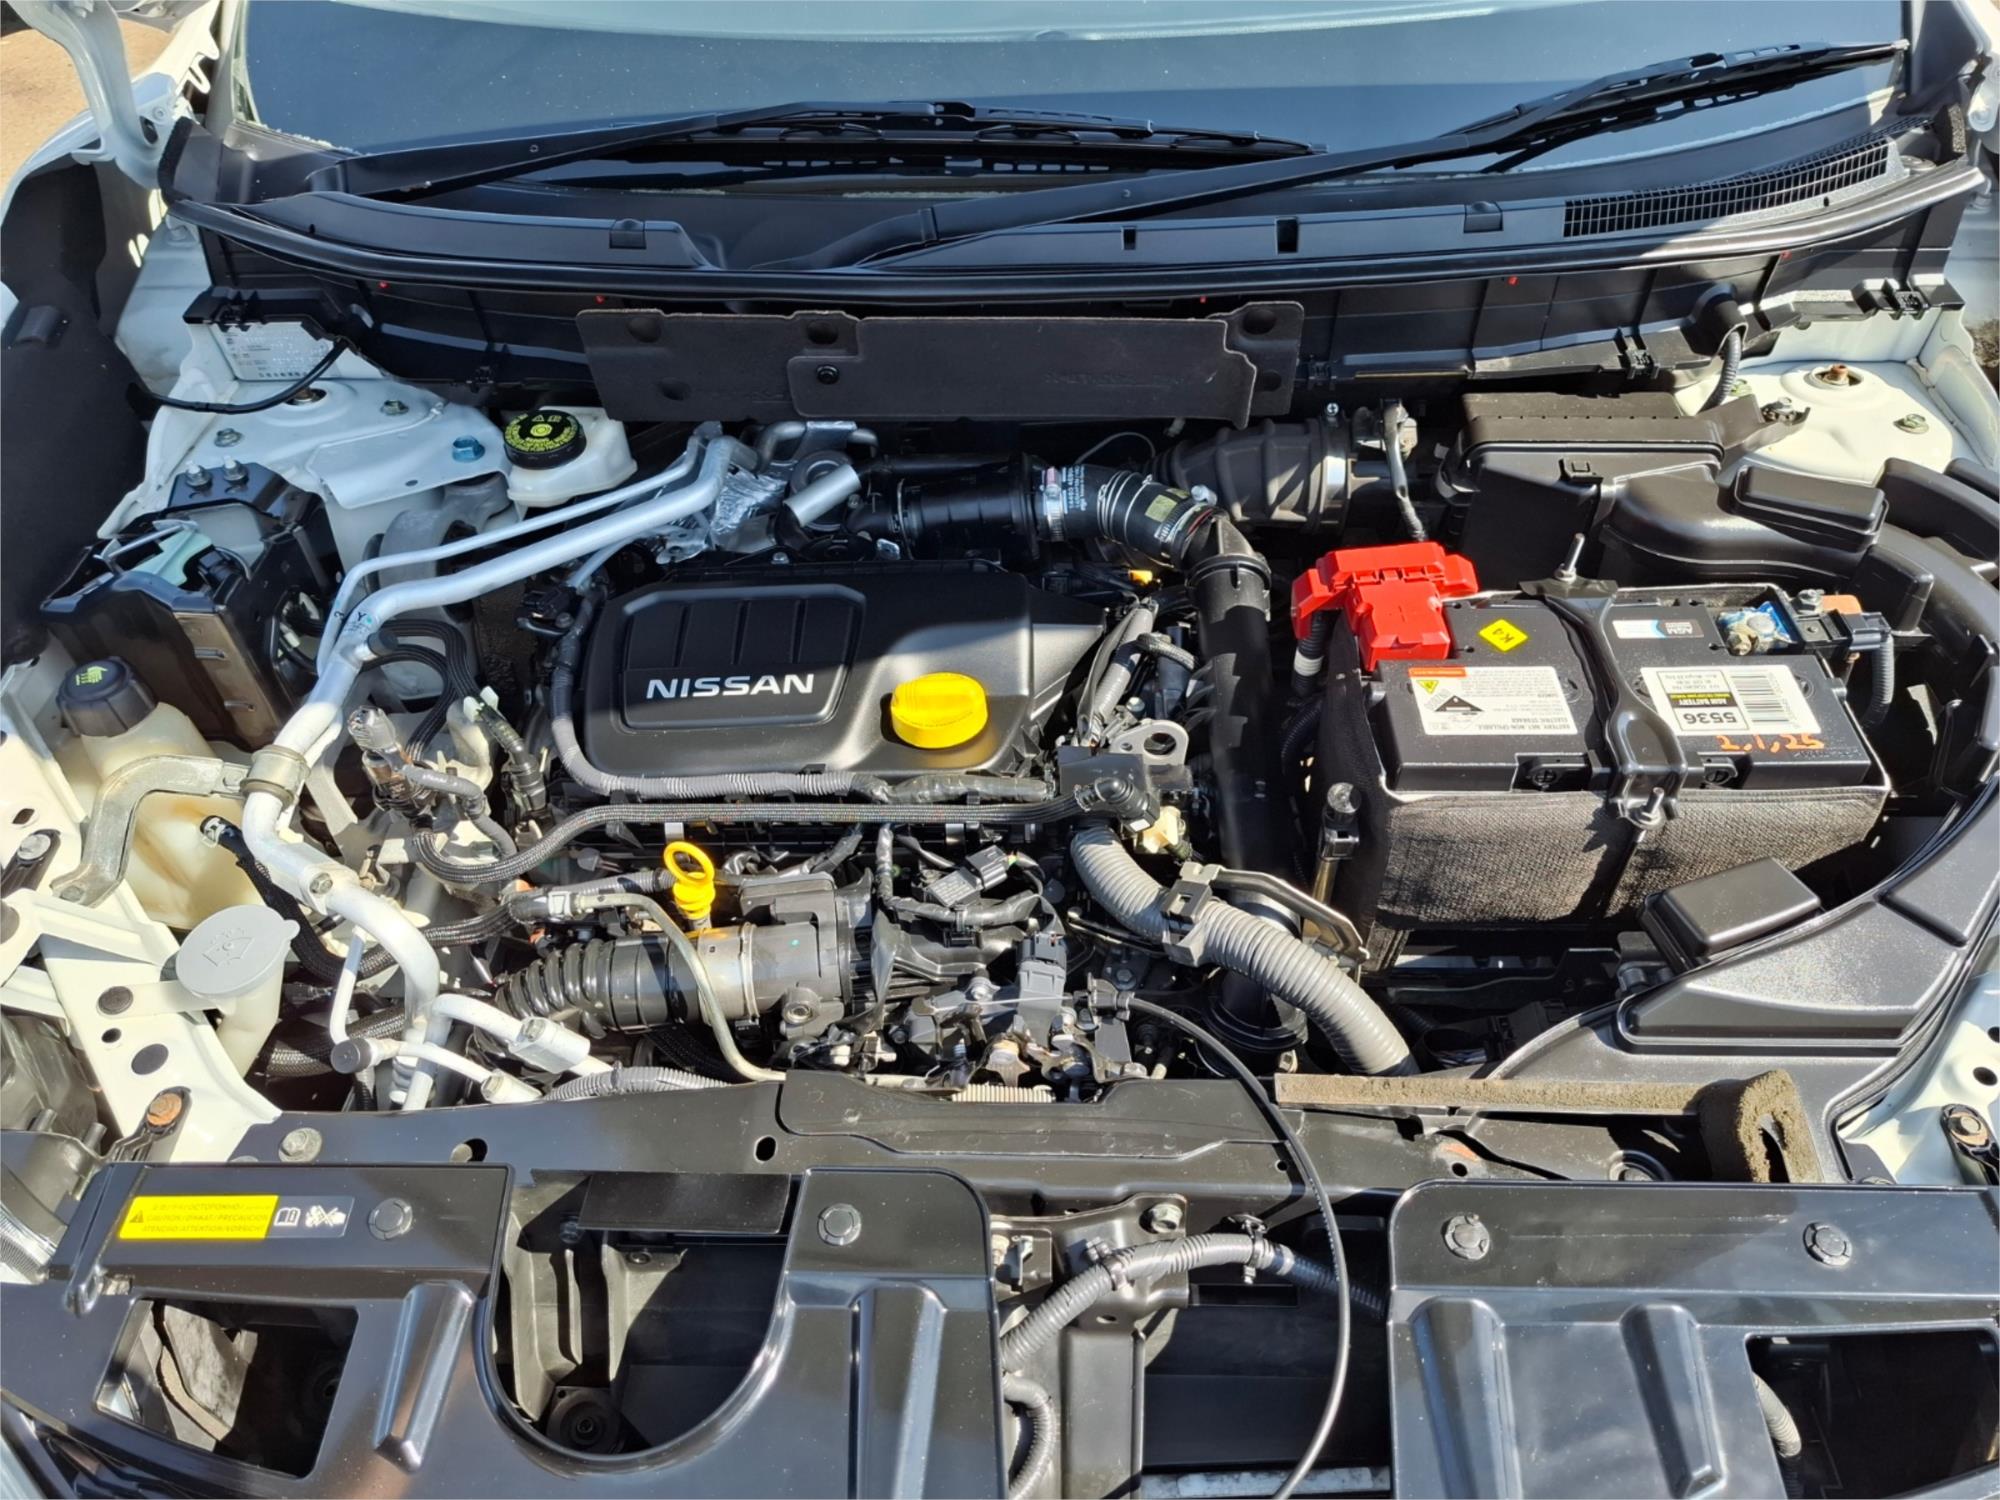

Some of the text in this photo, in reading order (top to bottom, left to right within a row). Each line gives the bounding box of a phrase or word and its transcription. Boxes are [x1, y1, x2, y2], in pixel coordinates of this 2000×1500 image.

[646, 674, 814, 699] NISSAN
[1680, 698, 1710, 706] BATTERY
[1683, 712, 1738, 725] 5536
